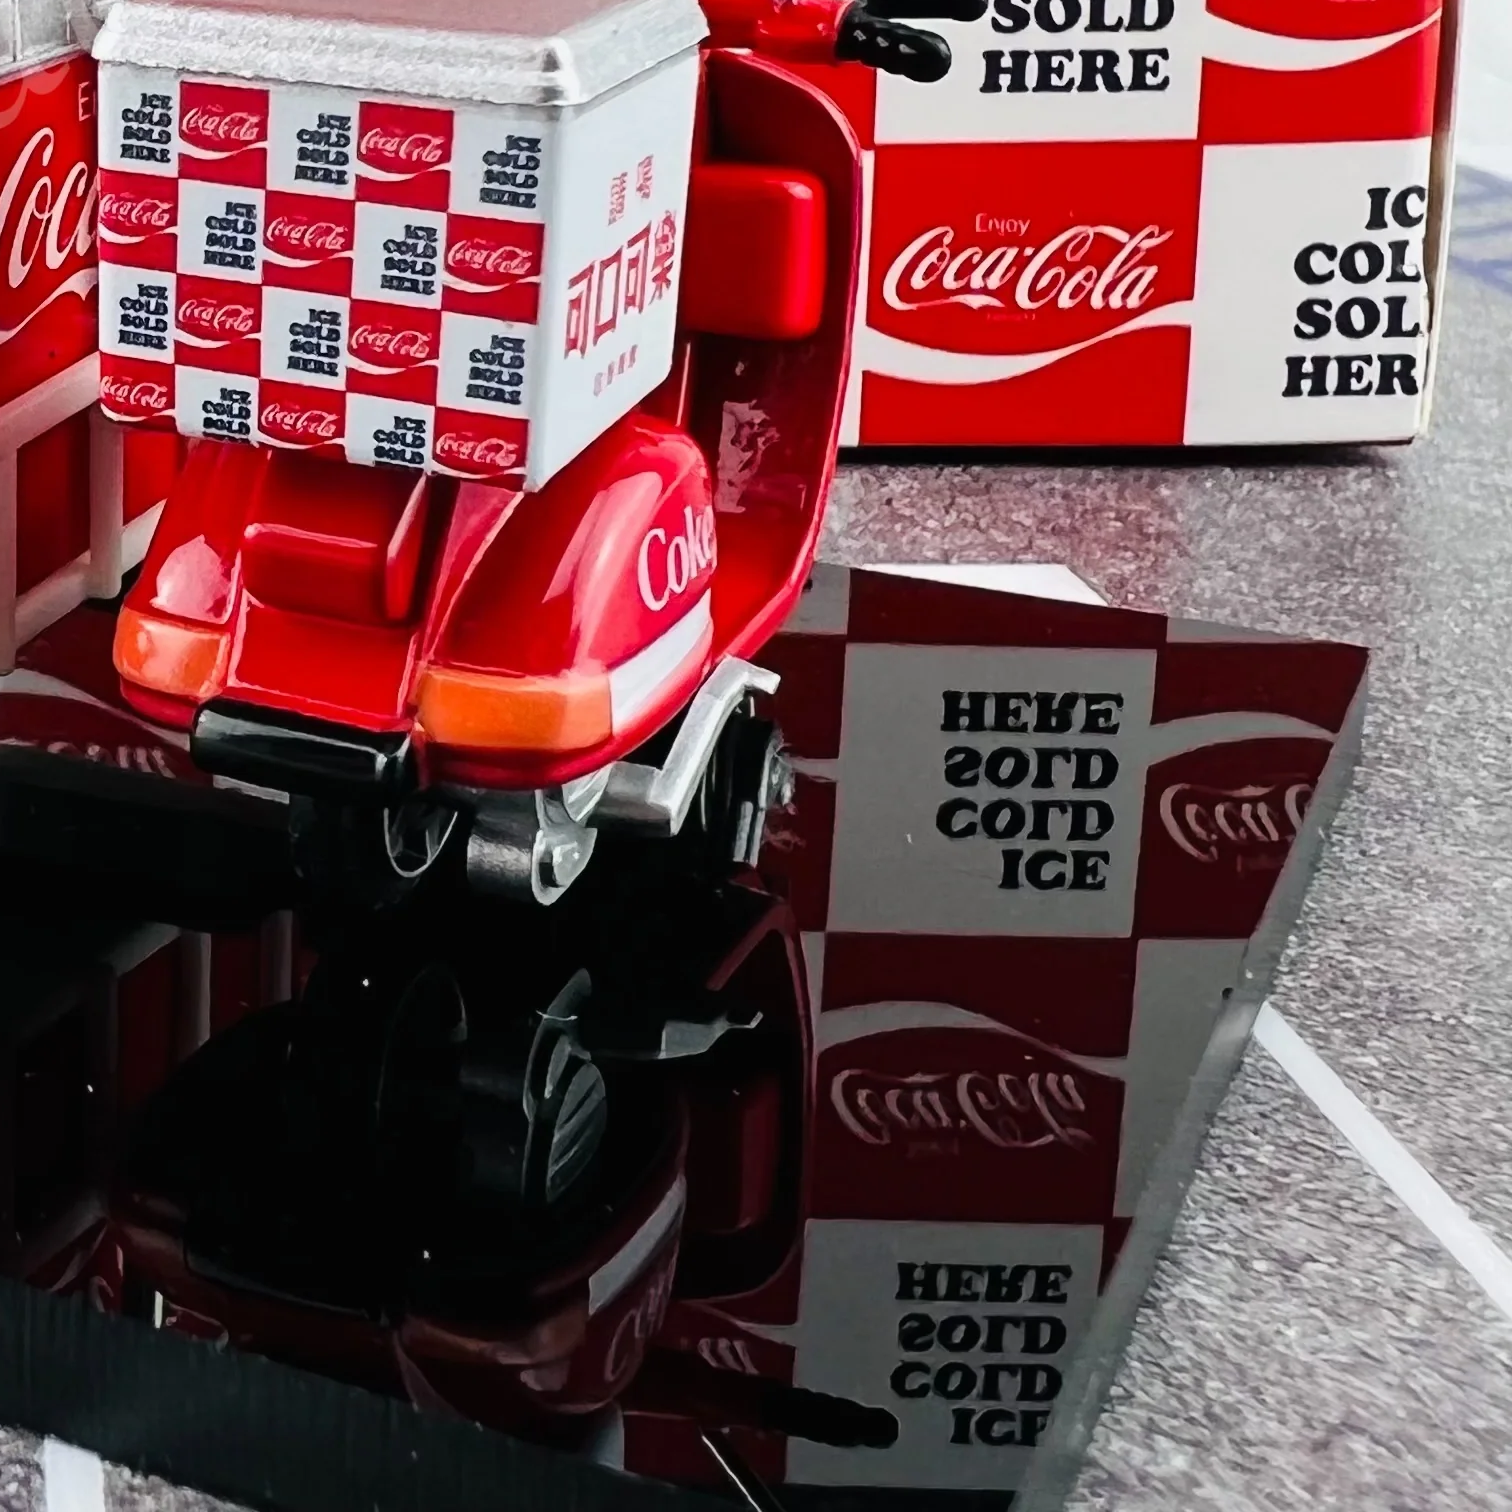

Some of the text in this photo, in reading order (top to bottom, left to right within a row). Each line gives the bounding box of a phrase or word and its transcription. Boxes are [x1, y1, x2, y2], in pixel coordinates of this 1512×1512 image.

[980, 48, 1169, 93] HERE
[976, 213, 1030, 236] Enjoy
[1365, 185, 1426, 230] IC
[883, 224, 1174, 311] Coca-Cola
[1294, 240, 1421, 285] COL
[1294, 296, 1420, 340] SOL
[1281, 354, 1419, 397] HER
[638, 505, 717, 611] Coke
